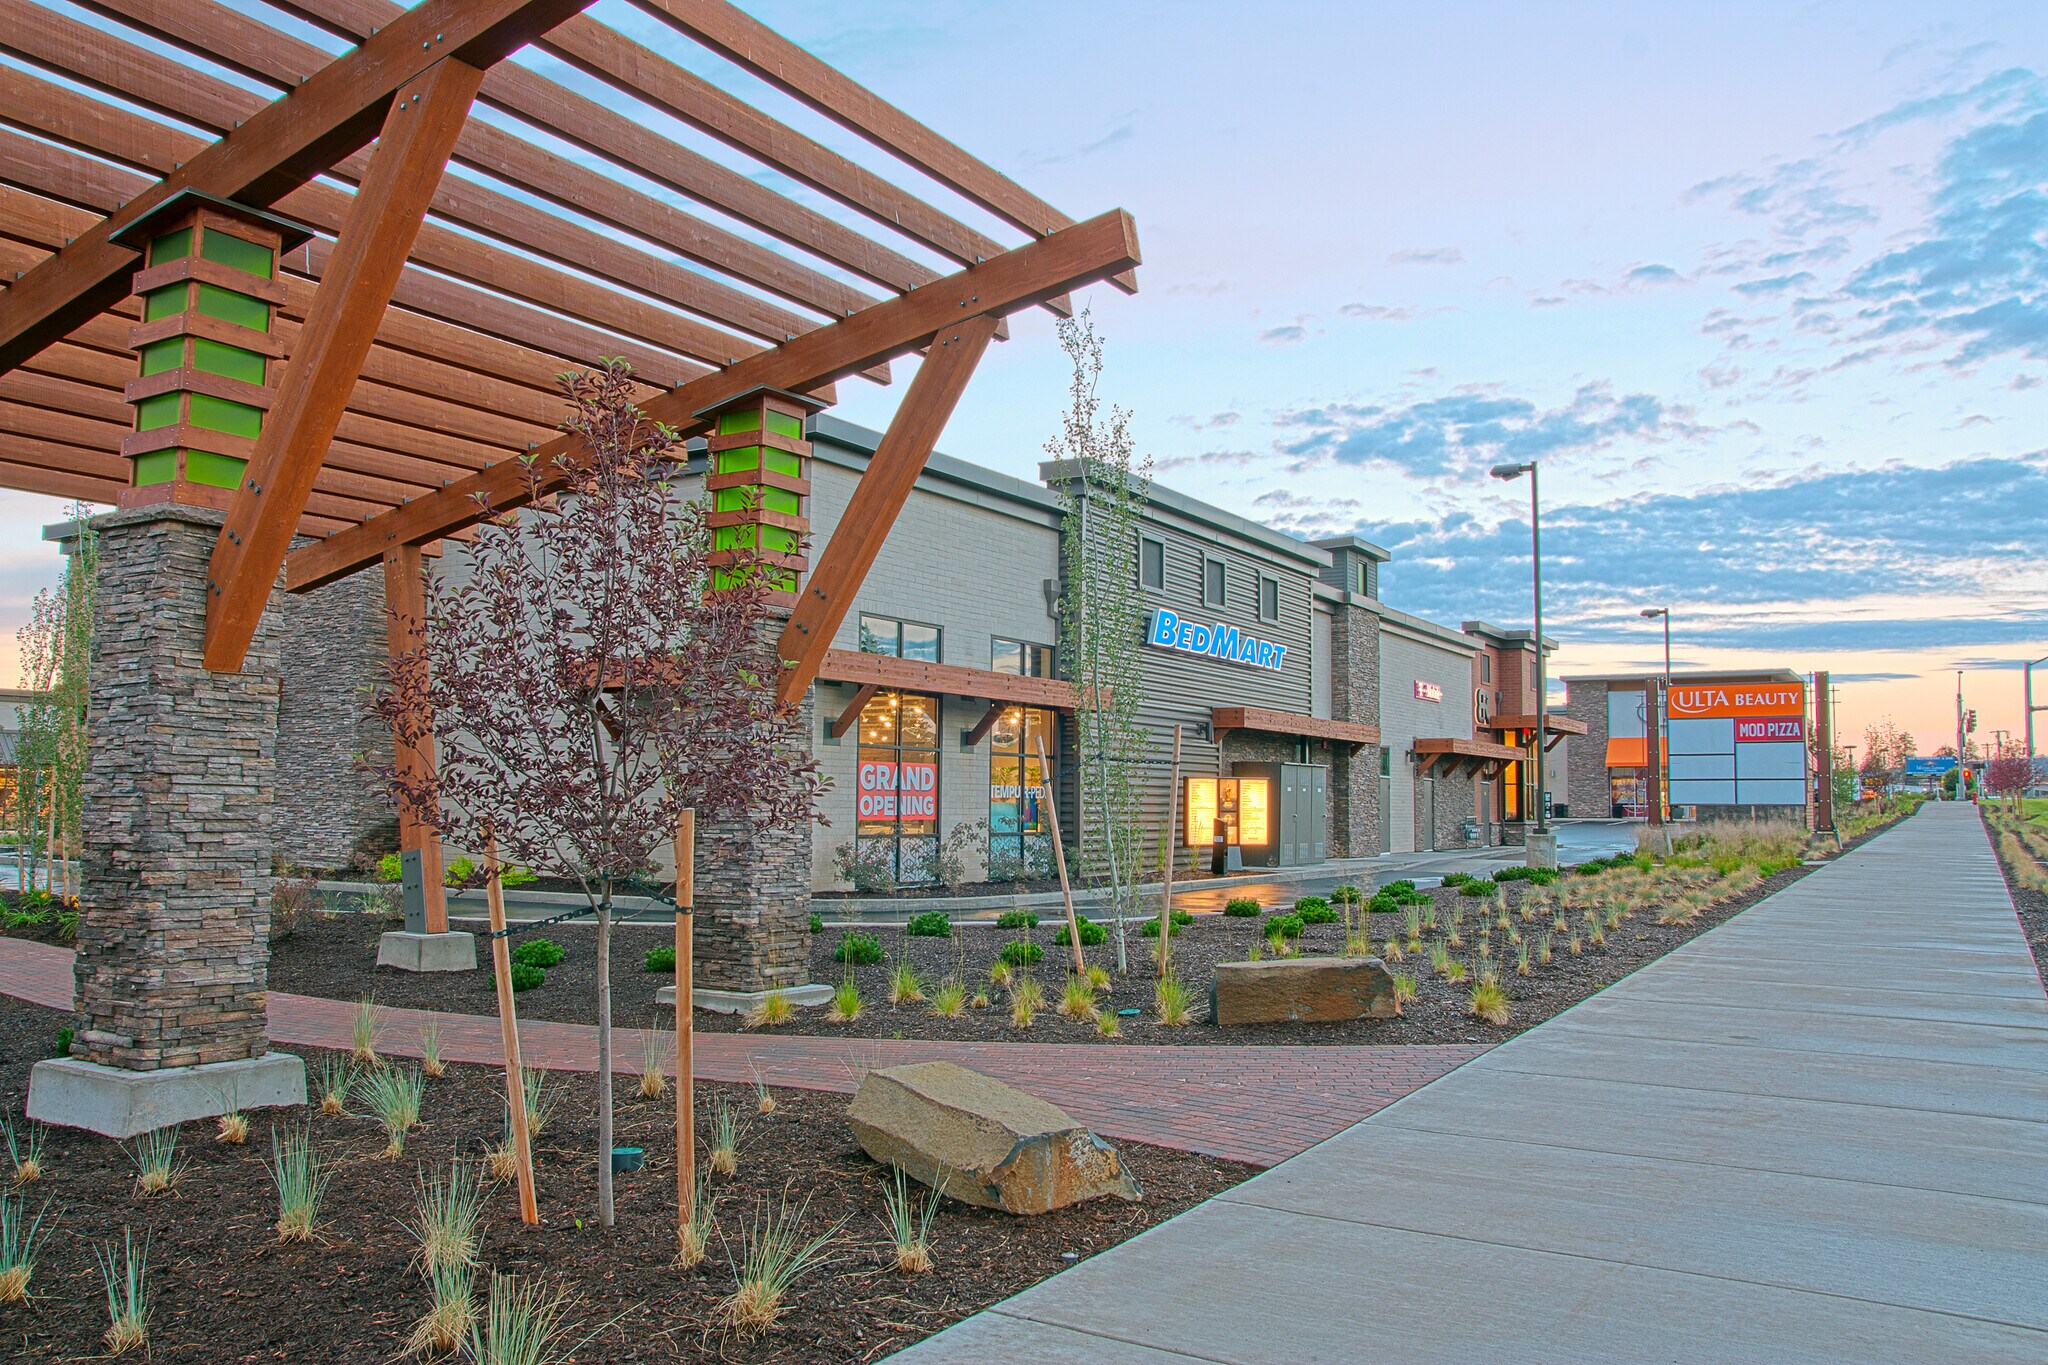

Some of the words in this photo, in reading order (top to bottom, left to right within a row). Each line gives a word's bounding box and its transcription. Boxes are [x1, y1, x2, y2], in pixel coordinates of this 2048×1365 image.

[1679, 690, 1729, 707] ULTA
[1735, 692, 1798, 706] BEAUTY
[1739, 723, 1765, 737] MOD
[1767, 722, 1801, 737] PIZZA
[860, 764, 934, 791] GRAND
[991, 784, 1047, 799] TEMPUR-PED
[860, 795, 934, 816] OPENING
